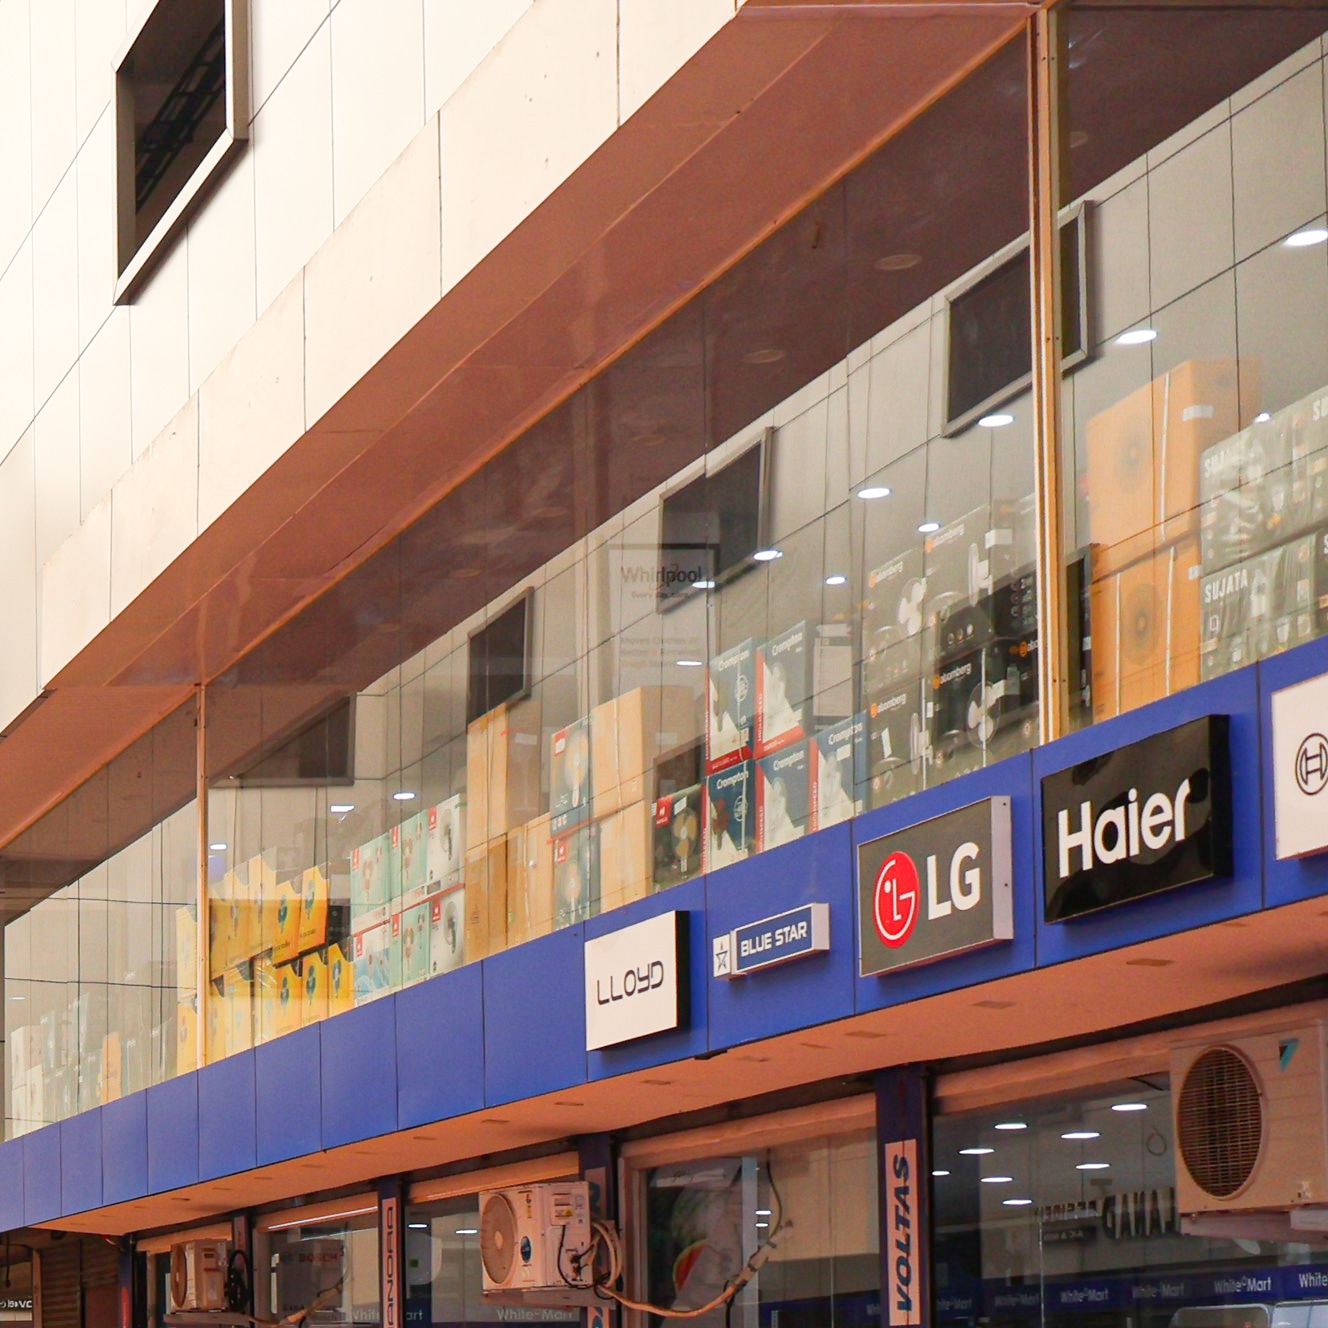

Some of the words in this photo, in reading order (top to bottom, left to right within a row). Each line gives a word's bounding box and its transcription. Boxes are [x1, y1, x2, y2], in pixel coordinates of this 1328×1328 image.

[622, 565, 702, 586] Whirlpool
[1204, 568, 1249, 604] SUJATA
[772, 632, 803, 656] Crompton
[773, 751, 804, 771] Crompton
[716, 769, 749, 790] Crompton
[1058, 778, 1191, 879] Haier
[926, 842, 981, 921] LG
[740, 931, 772, 957] BLUE
[775, 921, 808, 946] STAR
[596, 960, 665, 1006] LLOYD
[895, 1154, 912, 1313] VOLTAS
[1299, 1273, 1328, 1289] White
